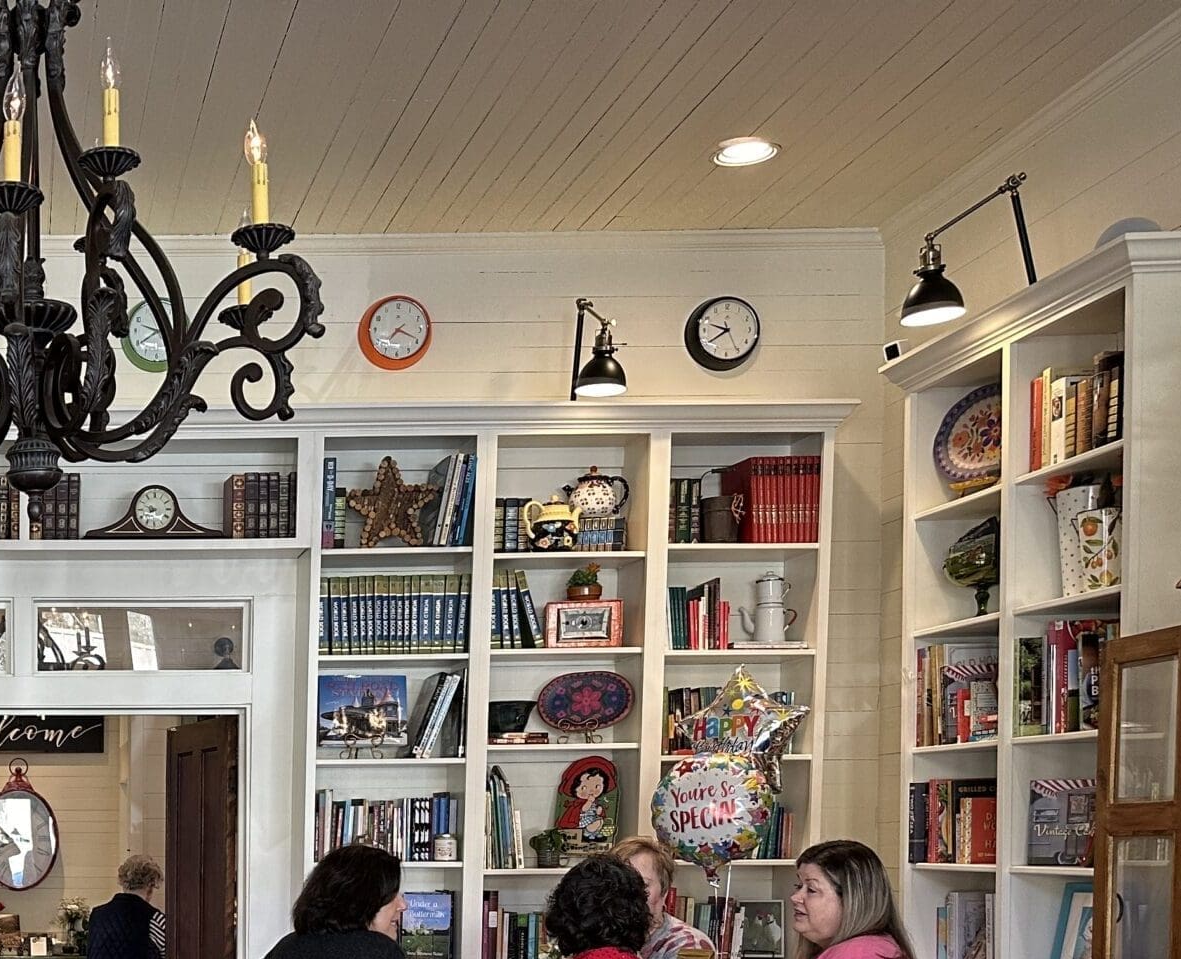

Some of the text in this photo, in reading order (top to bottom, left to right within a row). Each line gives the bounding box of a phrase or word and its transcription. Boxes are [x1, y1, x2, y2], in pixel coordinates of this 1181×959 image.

[670, 780, 736, 806] You're So
[670, 798, 743, 833] SPECIAL
[1033, 824, 1071, 840] Vintage
[410, 900, 431, 908] Under
